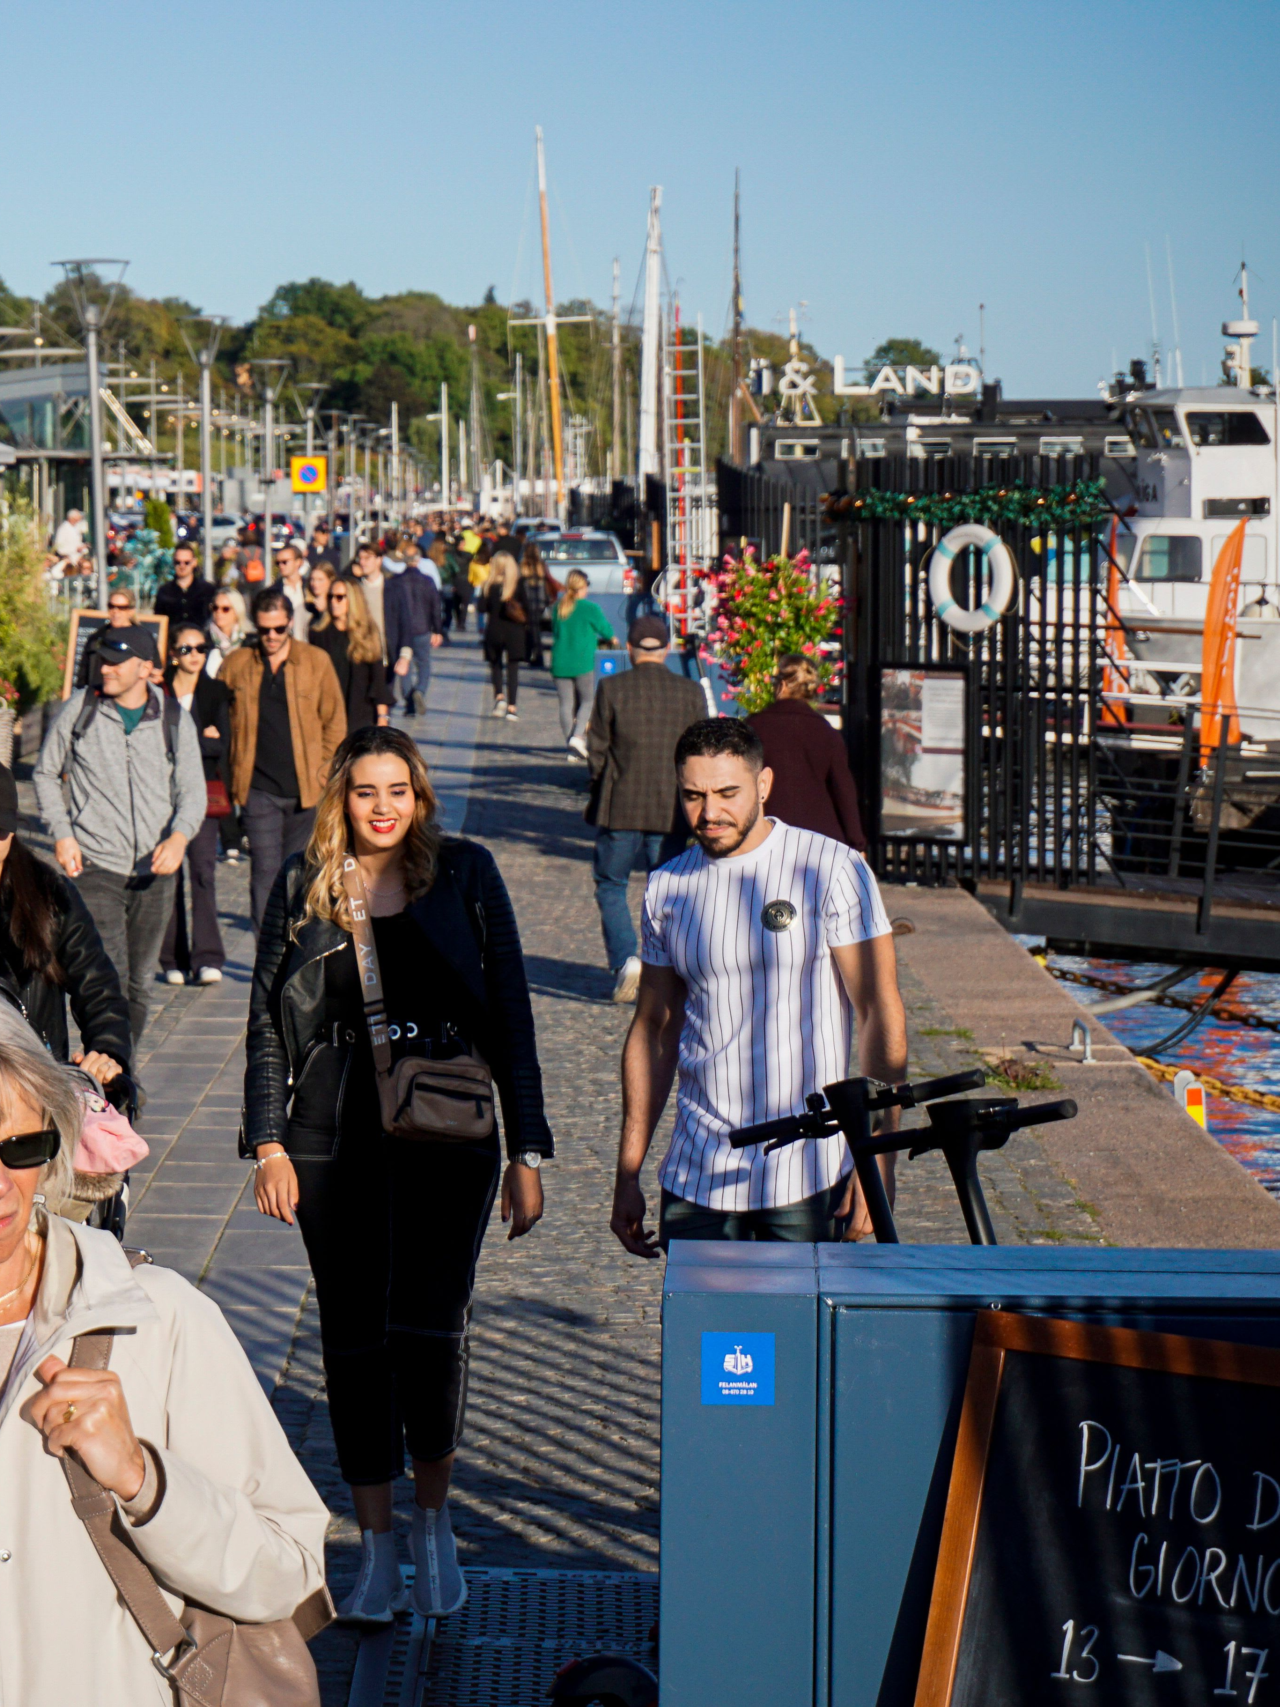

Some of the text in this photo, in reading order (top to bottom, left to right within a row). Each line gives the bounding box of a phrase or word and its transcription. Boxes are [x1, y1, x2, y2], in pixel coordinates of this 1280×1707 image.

[833, 354, 981, 396] LAND
[343, 852, 357, 872] D
[349, 897, 367, 922] ET
[358, 943, 378, 986] DAY
[1078, 1419, 1222, 1524] PIATTO
[1050, 1619, 1270, 1704] 13 17
